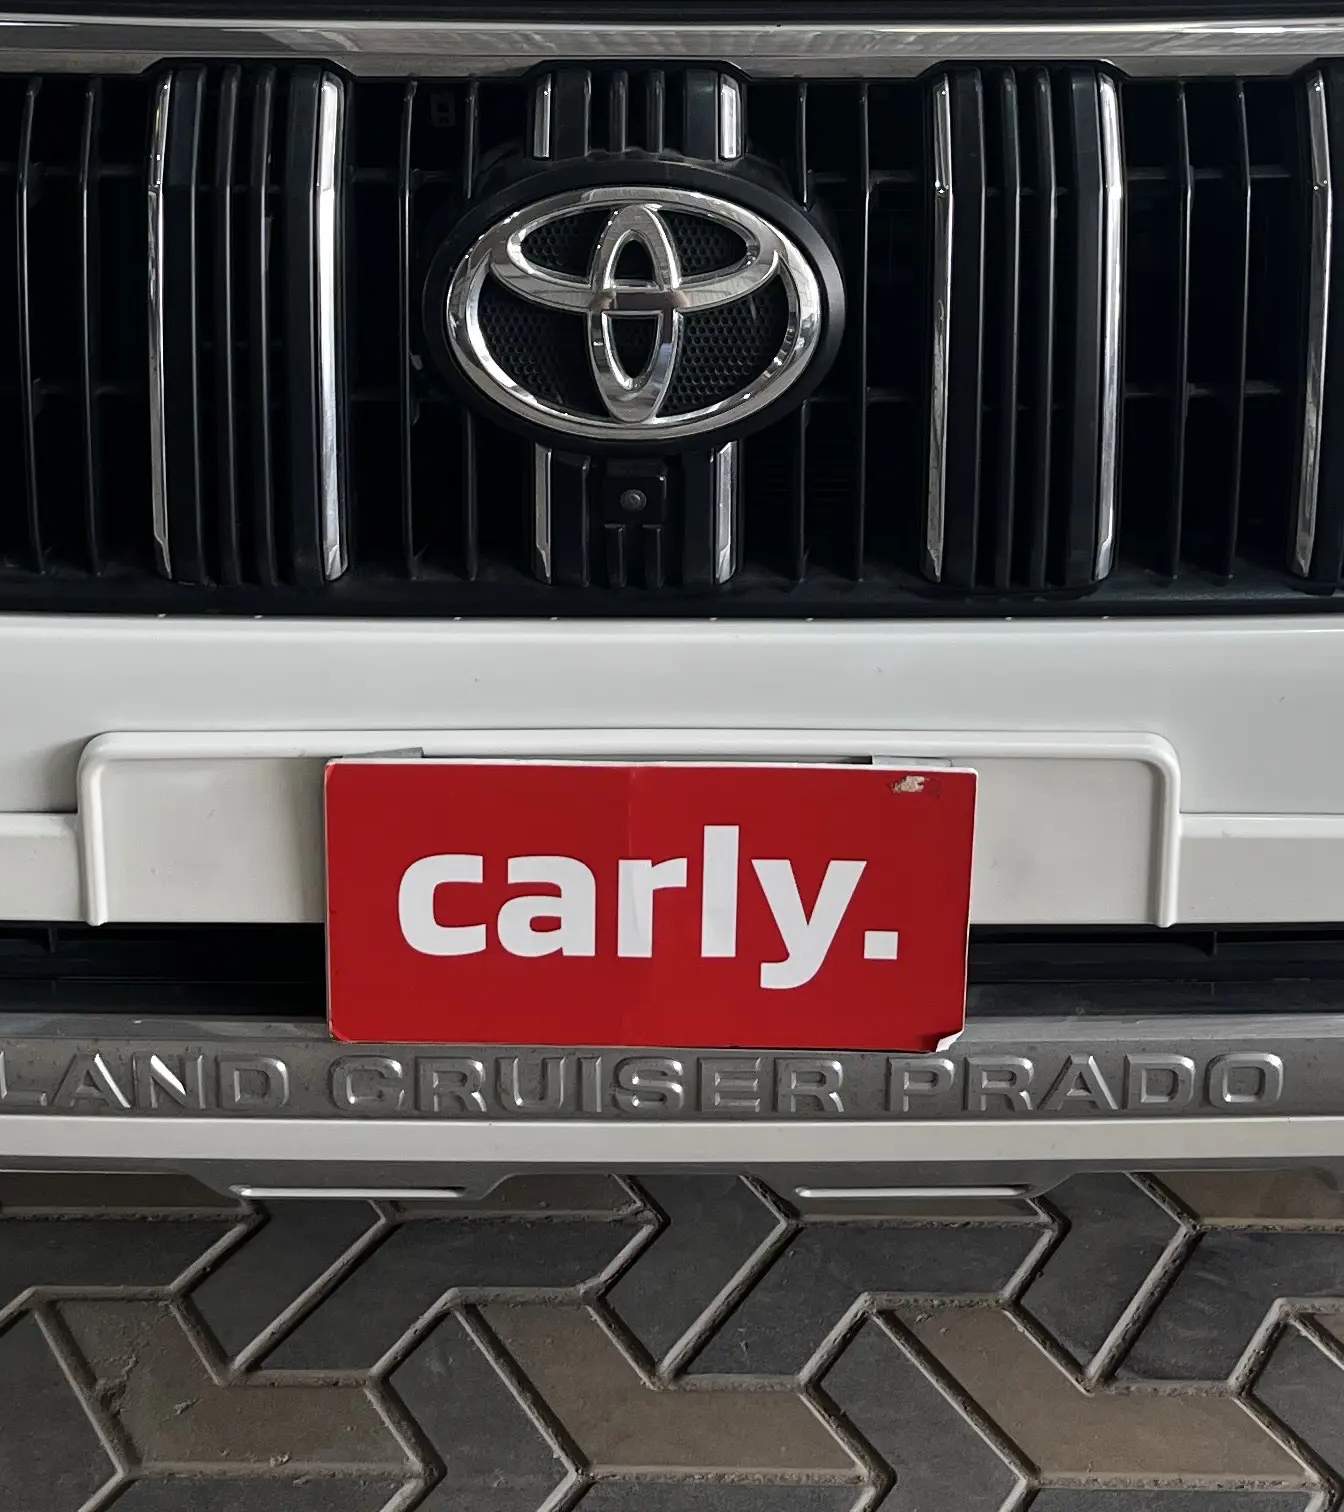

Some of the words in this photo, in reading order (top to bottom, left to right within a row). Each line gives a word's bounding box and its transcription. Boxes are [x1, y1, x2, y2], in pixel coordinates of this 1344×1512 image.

[398, 824, 899, 991] carly.
[329, 1055, 845, 1114] CRUISER
[885, 1052, 1285, 1113] PRADO
